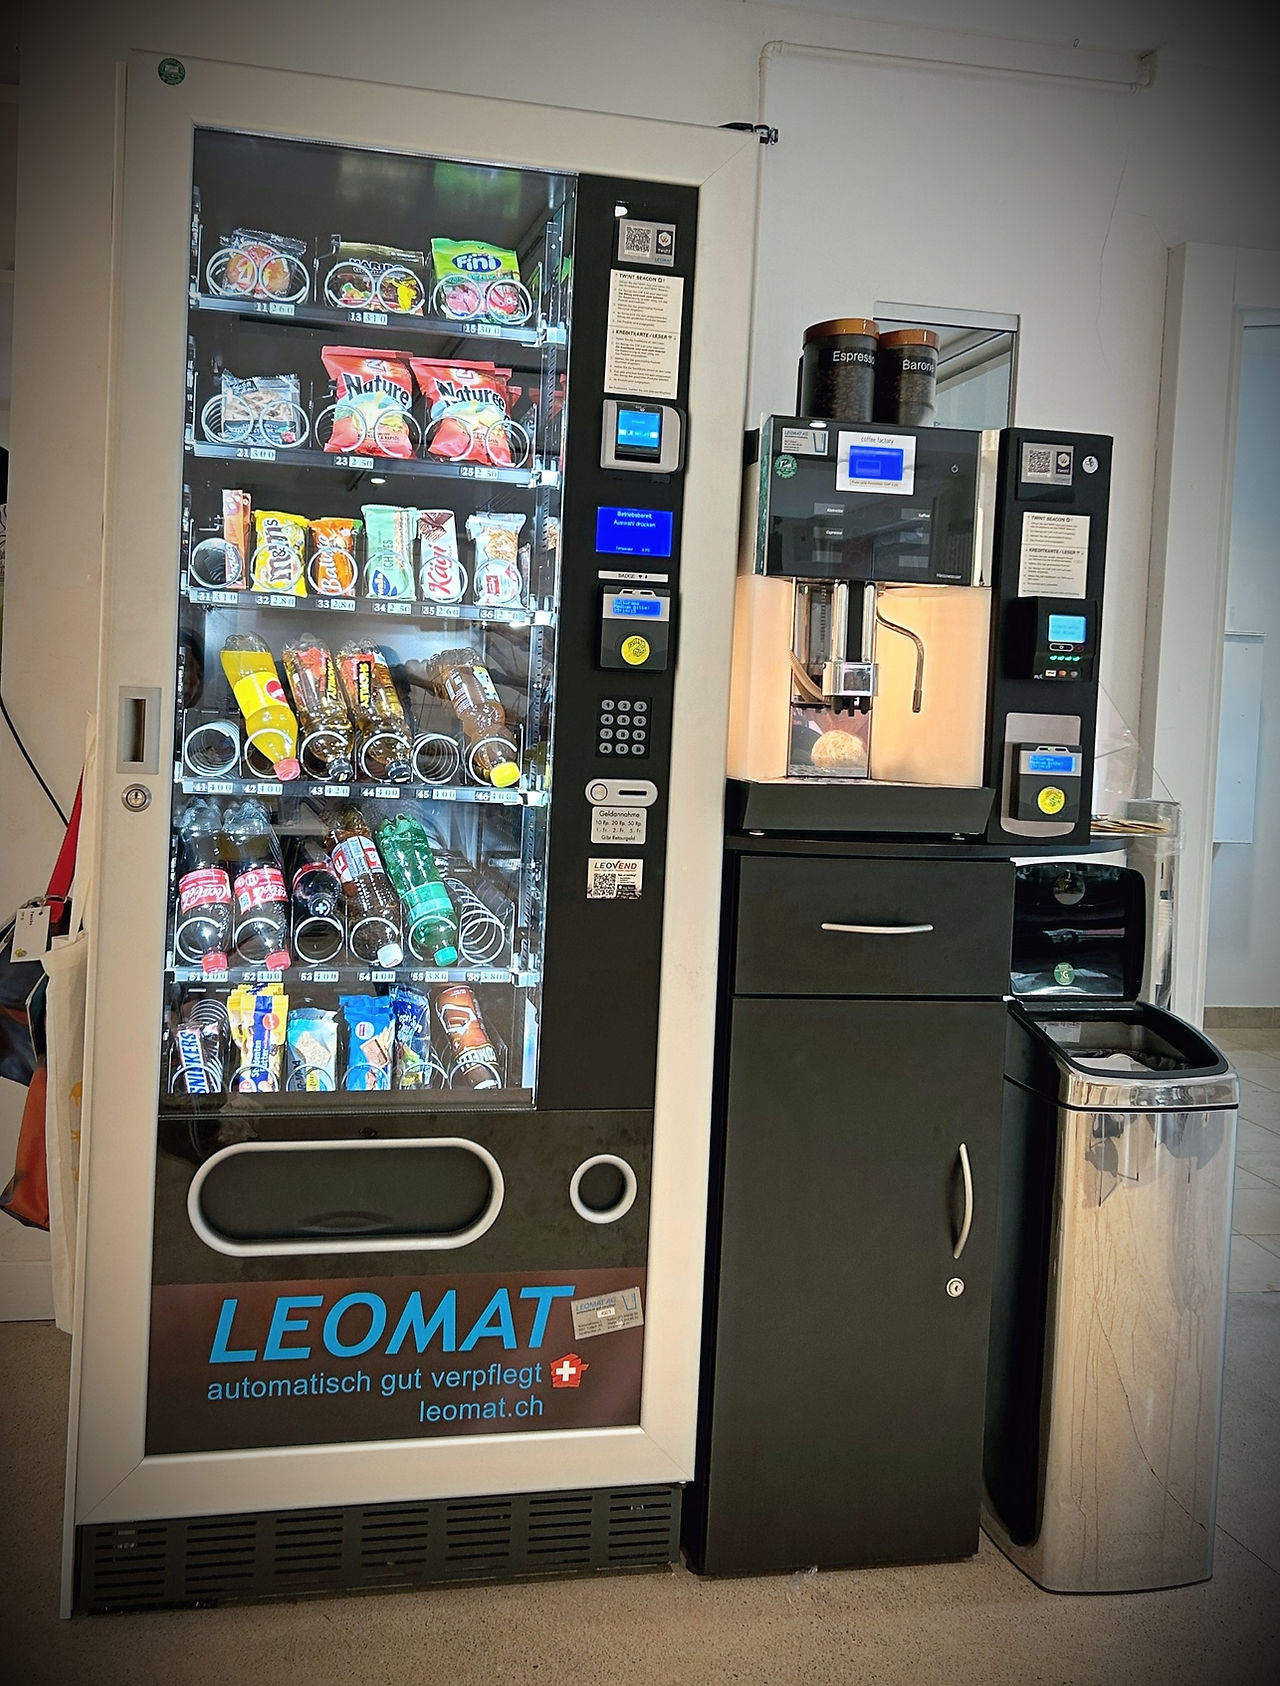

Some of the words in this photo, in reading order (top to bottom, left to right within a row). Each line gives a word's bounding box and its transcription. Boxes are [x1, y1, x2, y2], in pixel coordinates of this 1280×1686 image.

[456, 253, 497, 270] Fini
[616, 330, 649, 338] KREDITKARTE
[833, 351, 875, 365] Espresso
[343, 372, 409, 406] Nature
[861, 436, 877, 444] coffee
[878, 436, 895, 445] factory
[427, 544, 453, 594] Kägi
[359, 662, 370, 708] SHORLEY
[599, 810, 640, 818] Geldannahme
[594, 860, 637, 869] LEOVEND
[208, 1285, 575, 1363] LEOMAT
[207, 1370, 371, 1400] automatisch
[381, 1366, 422, 1398] gut
[431, 1362, 543, 1394] verpflegt
[419, 1396, 544, 1423] leomat.ch
